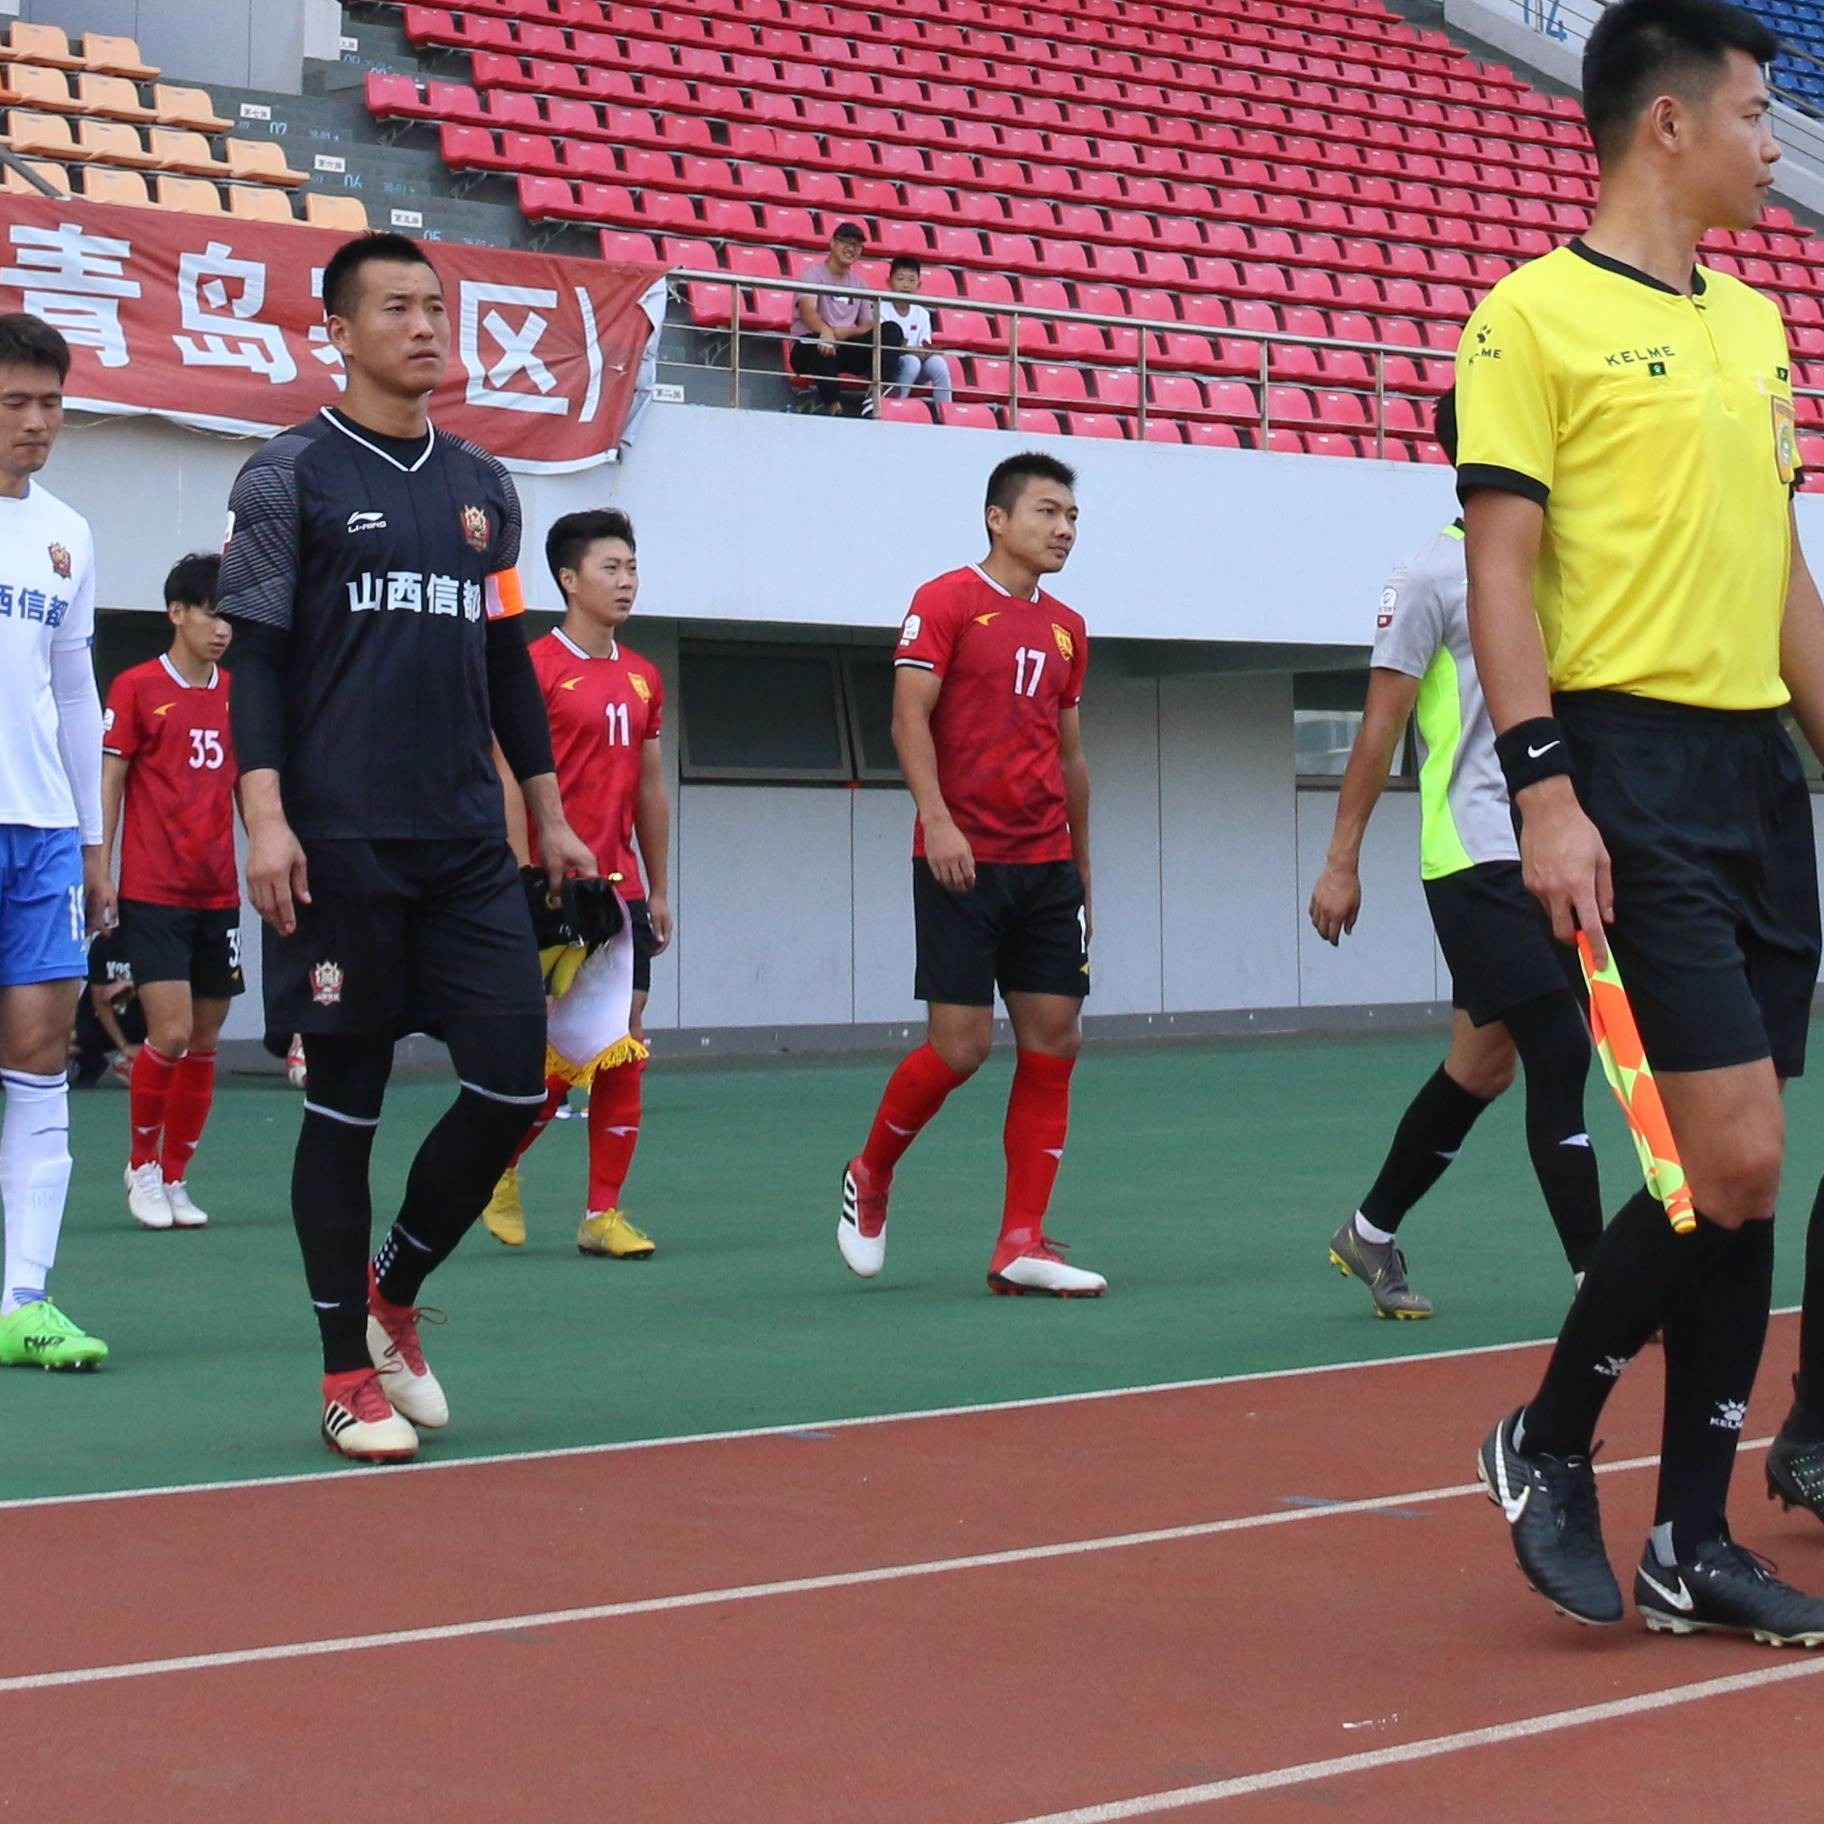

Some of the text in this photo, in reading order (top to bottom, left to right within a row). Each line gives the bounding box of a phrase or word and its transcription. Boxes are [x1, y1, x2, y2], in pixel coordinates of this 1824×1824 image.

[243, 107, 269, 121] 第七排
[317, 157, 343, 172] 第六排
[394, 214, 420, 227] 第五排
[1604, 345, 1676, 368] KELME
[345, 570, 482, 624] 山西信都
[1014, 646, 1047, 699] 17
[605, 702, 630, 748] 11
[188, 728, 224, 771] 35
[225, 927, 241, 969] 3
